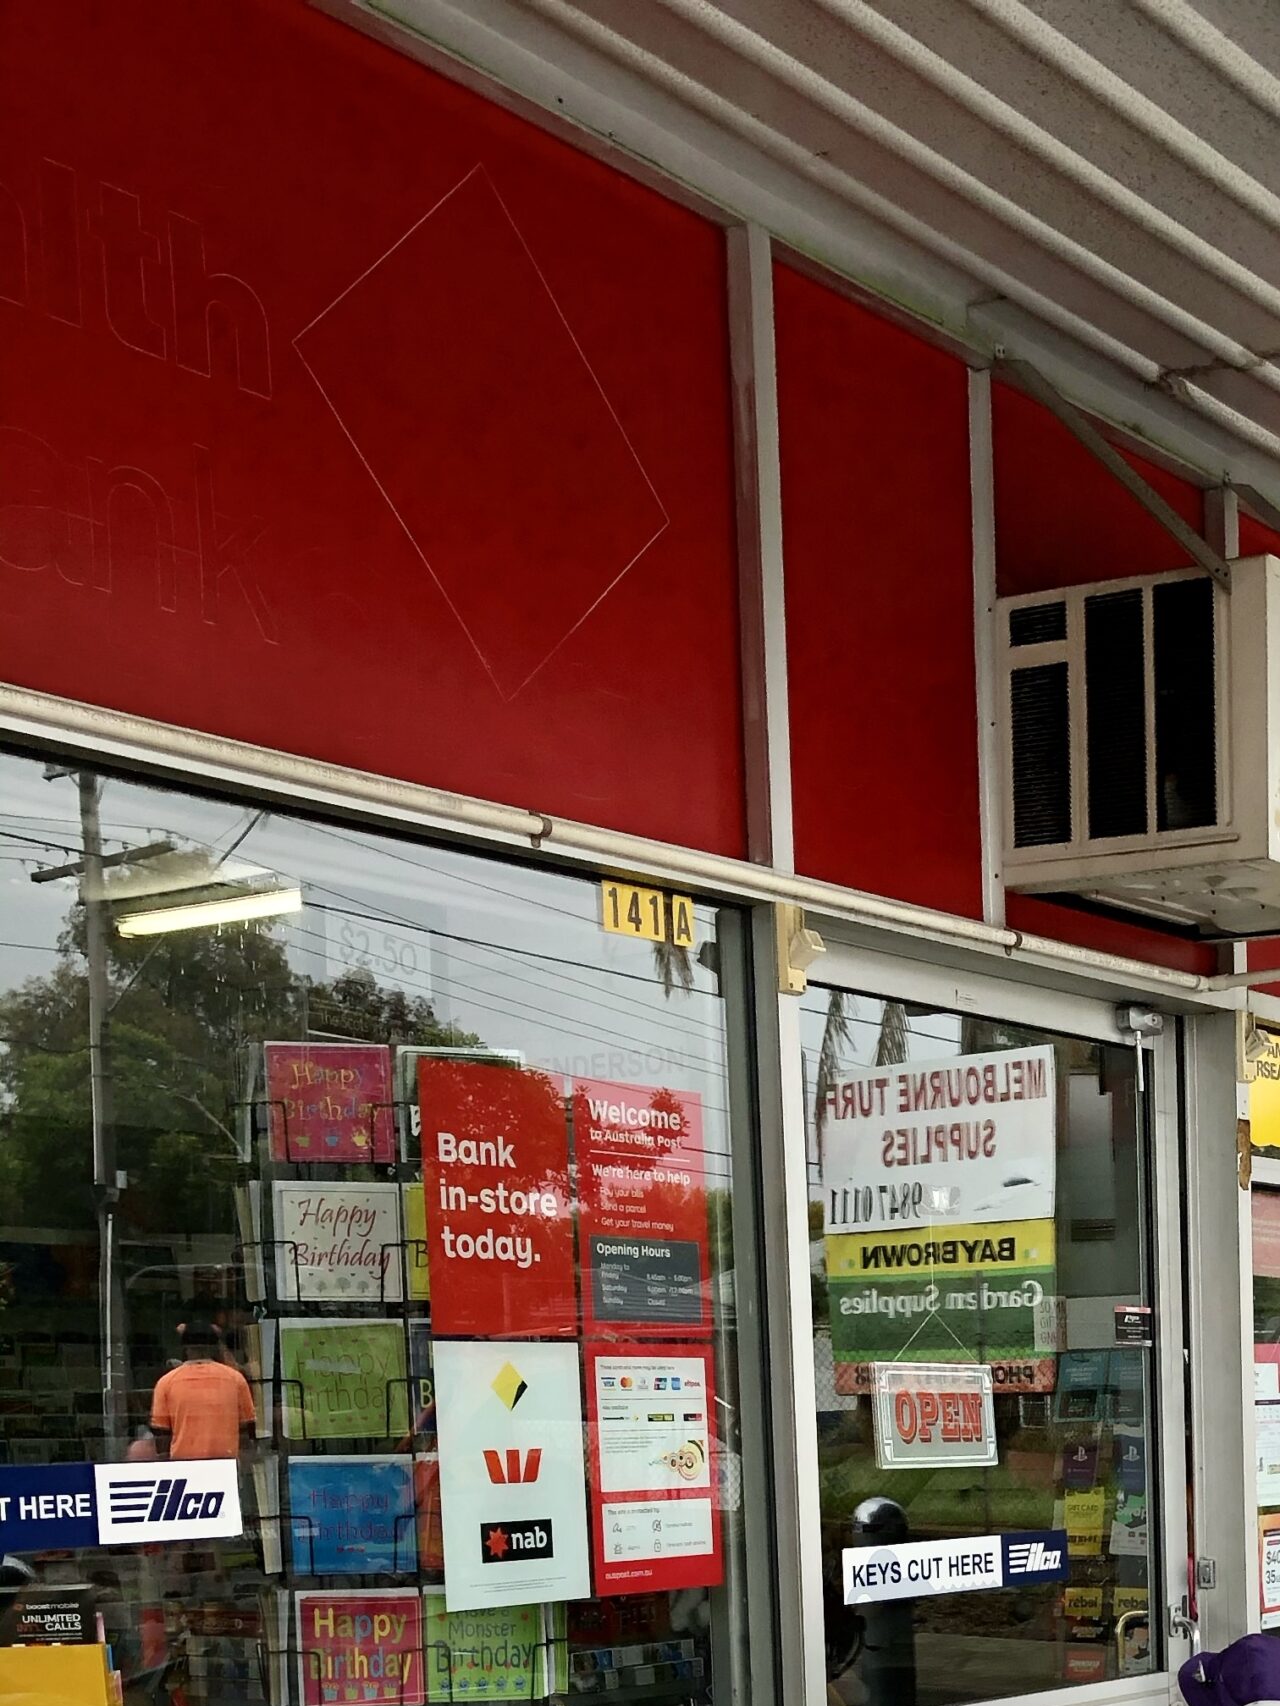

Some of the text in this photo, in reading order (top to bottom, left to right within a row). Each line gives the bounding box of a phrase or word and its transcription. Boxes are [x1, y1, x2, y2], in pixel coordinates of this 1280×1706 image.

[607, 886, 692, 943] 141 A
[339, 922, 417, 975] $2.50
[291, 1059, 366, 1090] Happy
[283, 1096, 379, 1122] Birthday
[588, 1099, 680, 1130] Welcome
[437, 1132, 516, 1168] Bank
[590, 1127, 681, 1148] to Australia Post
[592, 1163, 690, 1185] We're here to help
[439, 1178, 558, 1217] in-store
[600, 1202, 617, 1211] Send
[625, 1204, 646, 1213] parcel
[615, 1189, 630, 1199] your
[298, 1198, 377, 1237] Happy
[601, 1217, 674, 1232] Get your travel money
[288, 1239, 391, 1280] Birthday
[441, 1225, 541, 1269] today.
[596, 1242, 671, 1258] Opening Hours
[296, 1349, 391, 1385] Happy
[894, 1389, 983, 1444] OPEN
[19, 1493, 92, 1520] HERE
[511, 1526, 547, 1550] nab
[852, 1561, 901, 1588] KEYS
[907, 1557, 943, 1581] CUT
[949, 1552, 994, 1577] HERE
[1068, 1595, 1098, 1608] rebel
[22, 1613, 81, 1624] UNLIMITED
[45, 1622, 82, 1632] CALLS
[314, 1607, 407, 1645] Happy
[449, 1619, 517, 1641] Monster
[310, 1646, 412, 1685] Birthday
[436, 1639, 533, 1674] Birthday
